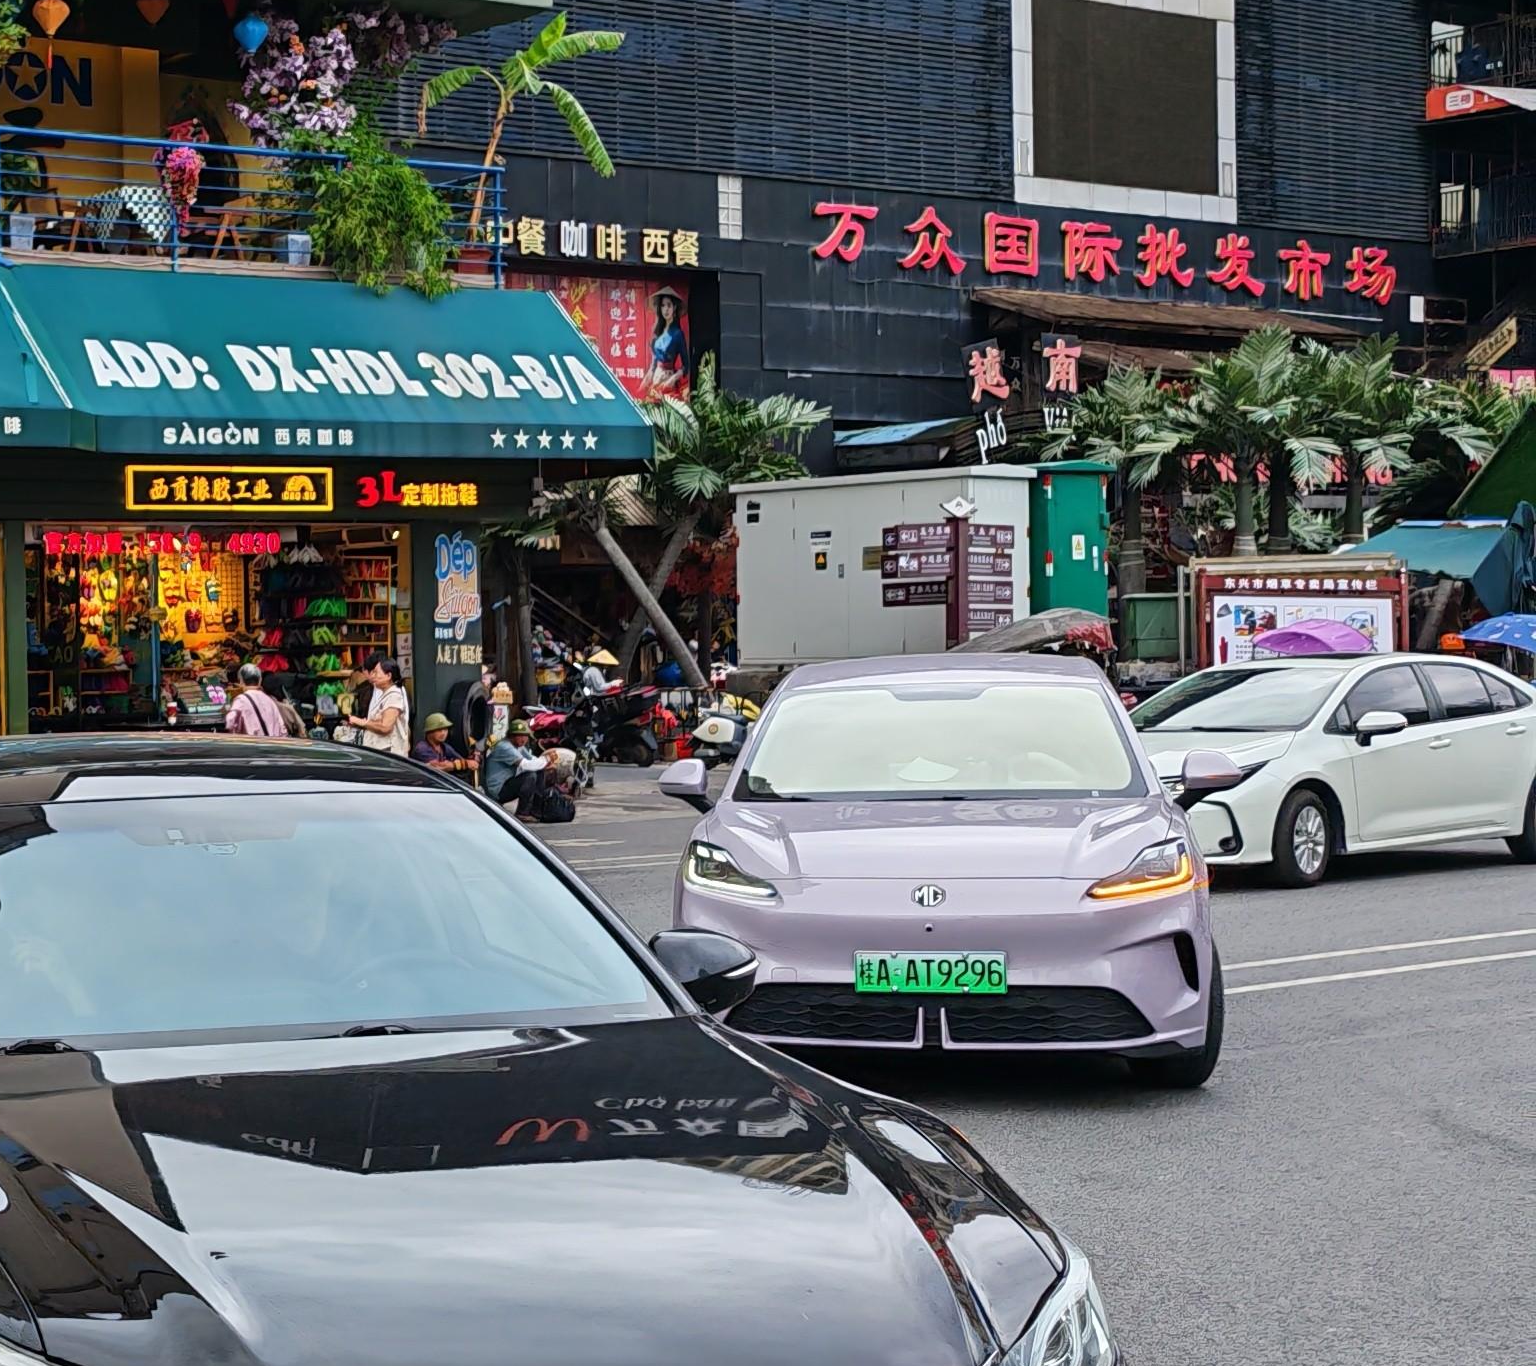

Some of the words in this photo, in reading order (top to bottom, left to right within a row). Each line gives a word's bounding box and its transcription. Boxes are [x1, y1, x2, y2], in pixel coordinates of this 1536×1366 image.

[560, 219, 627, 262] 咖啡
[642, 228, 699, 267] 西餐
[812, 201, 1398, 306] 万众国际批发市场
[82, 338, 221, 392] ADD:
[228, 344, 430, 399] DX-HDL
[421, 353, 616, 404] 302-B/A
[163, 421, 260, 446] SÀIGÒN
[275, 428, 354, 447] 西贡咖啡
[149, 476, 273, 502] 西贡橡胶工业
[1224, 577, 1378, 590] 东兴市烟草专卖局宣传栏
[914, 885, 944, 907] MG
